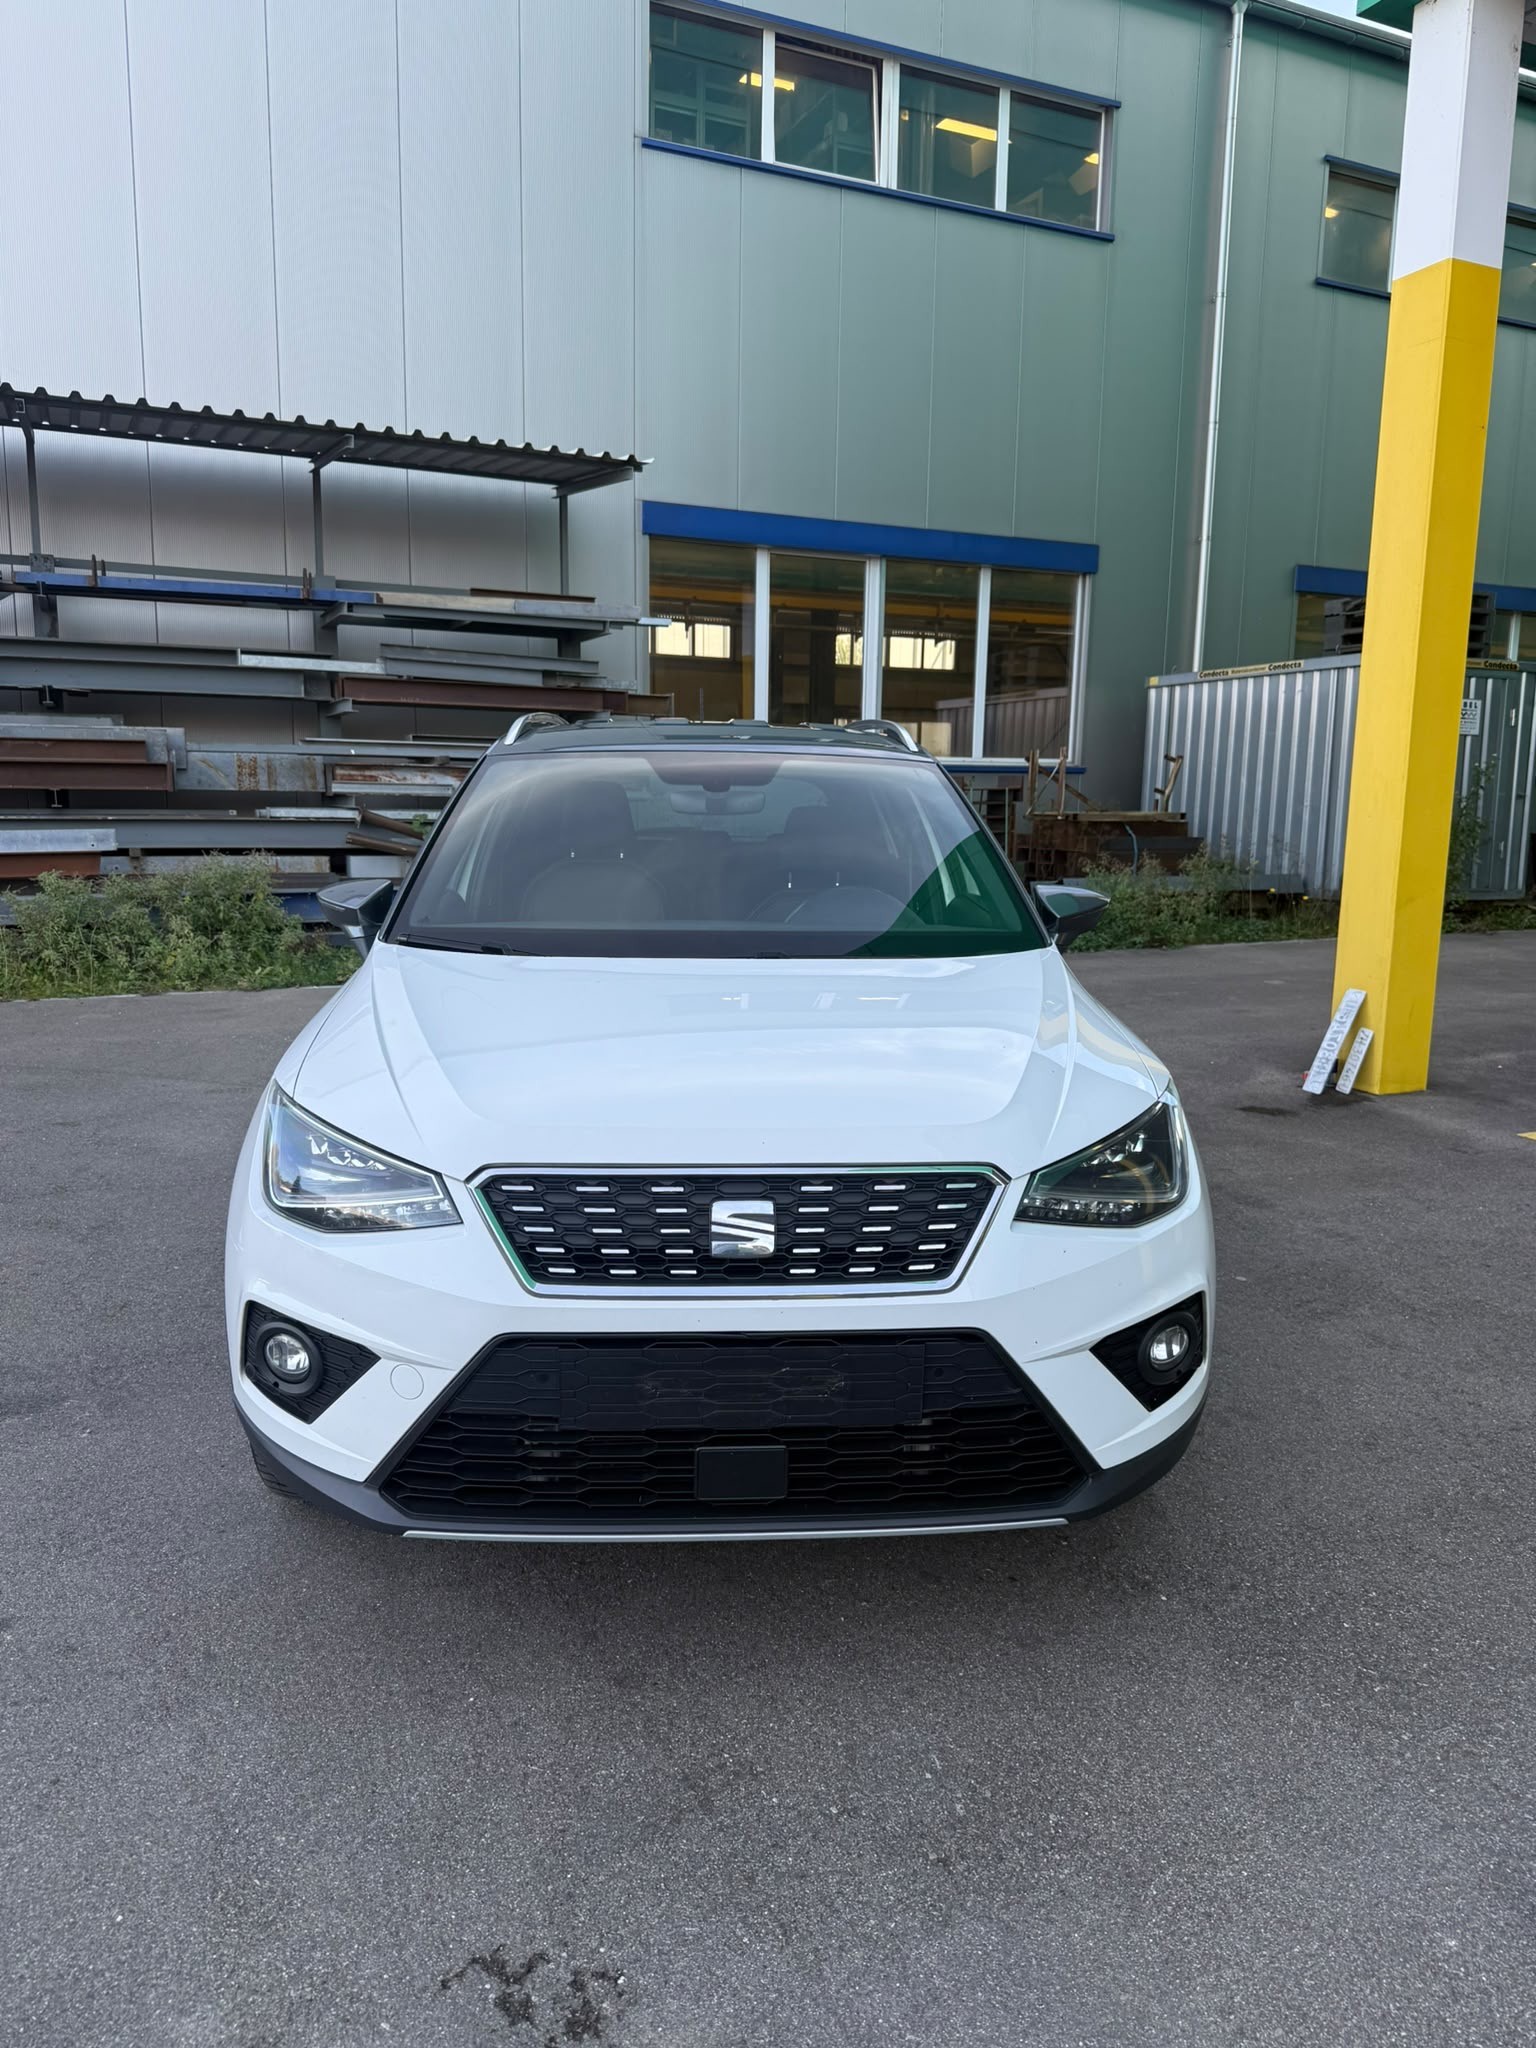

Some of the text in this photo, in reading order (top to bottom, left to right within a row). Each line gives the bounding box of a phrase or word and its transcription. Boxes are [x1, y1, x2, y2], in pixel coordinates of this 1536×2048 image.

[1199, 670, 1229, 679] Condecta
[1268, 661, 1302, 671] Condecta
[1483, 660, 1518, 669] Condecta
